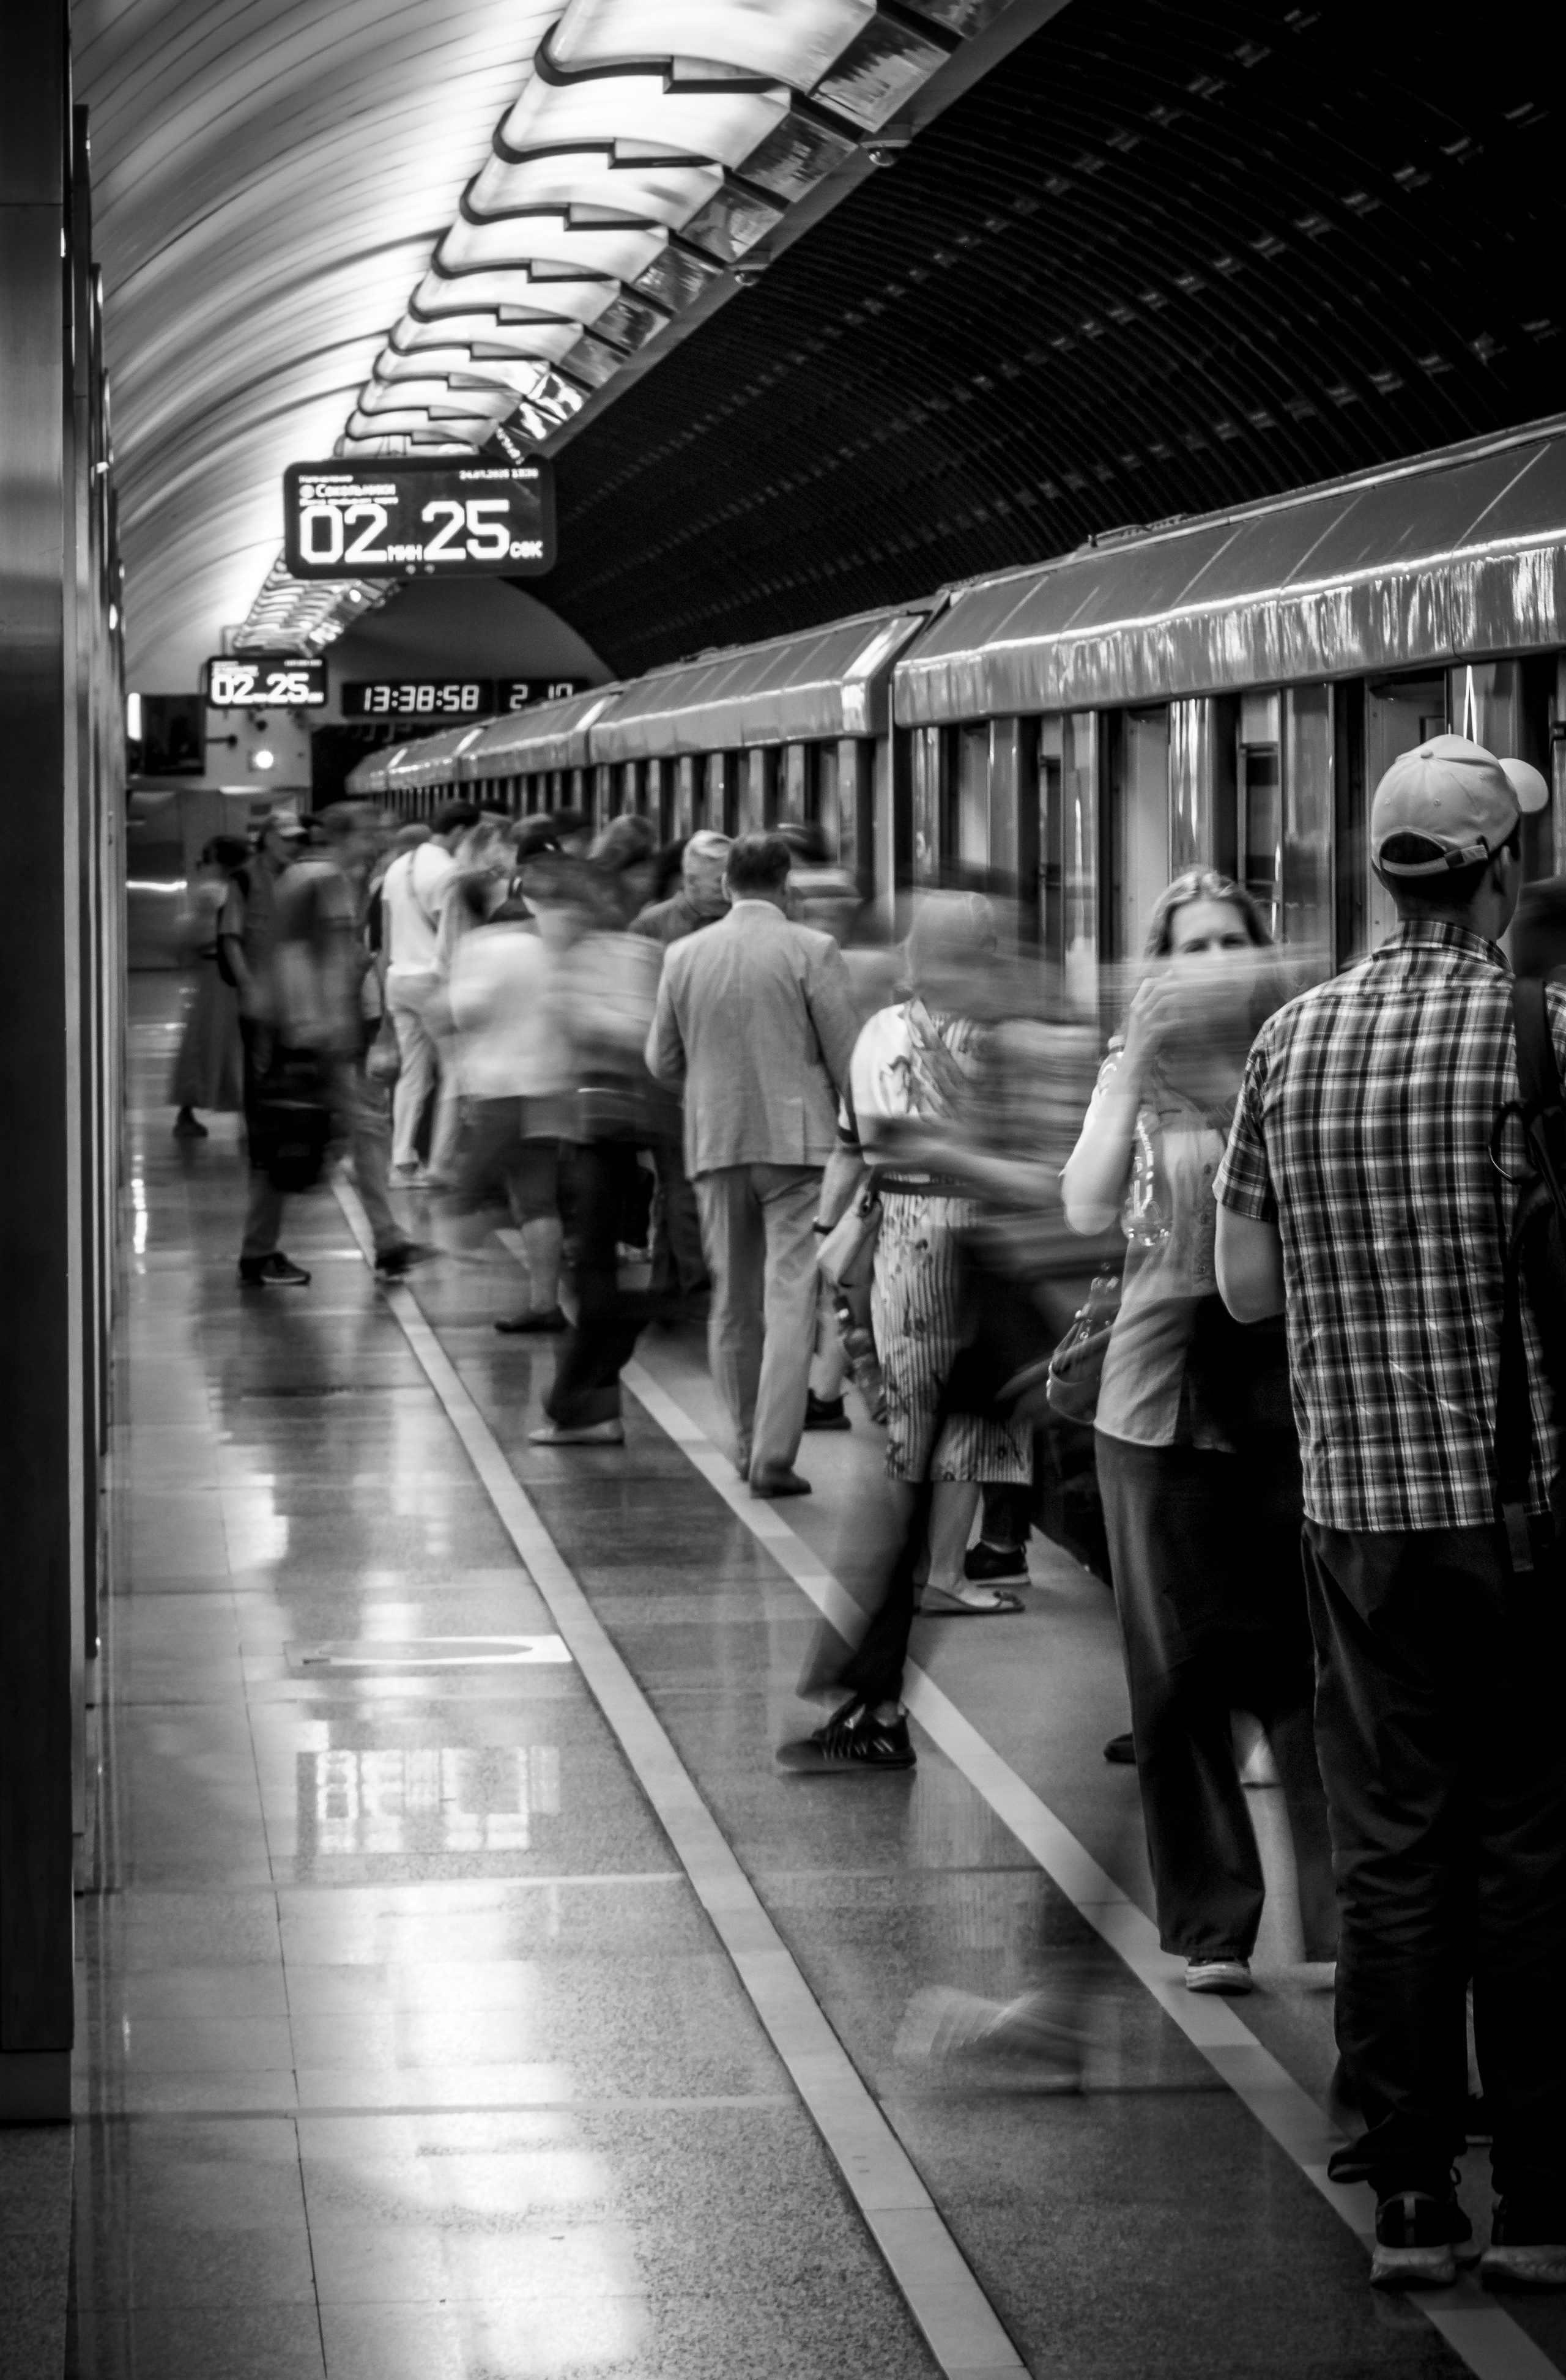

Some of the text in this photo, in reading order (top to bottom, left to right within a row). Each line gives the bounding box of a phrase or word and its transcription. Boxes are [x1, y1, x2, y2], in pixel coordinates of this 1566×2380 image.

[300, 503, 387, 563] 02
[421, 499, 510, 560] 25
[212, 672, 309, 704] 02 25
[364, 685, 479, 711] 13:38:58
[510, 684, 529, 709] 2
